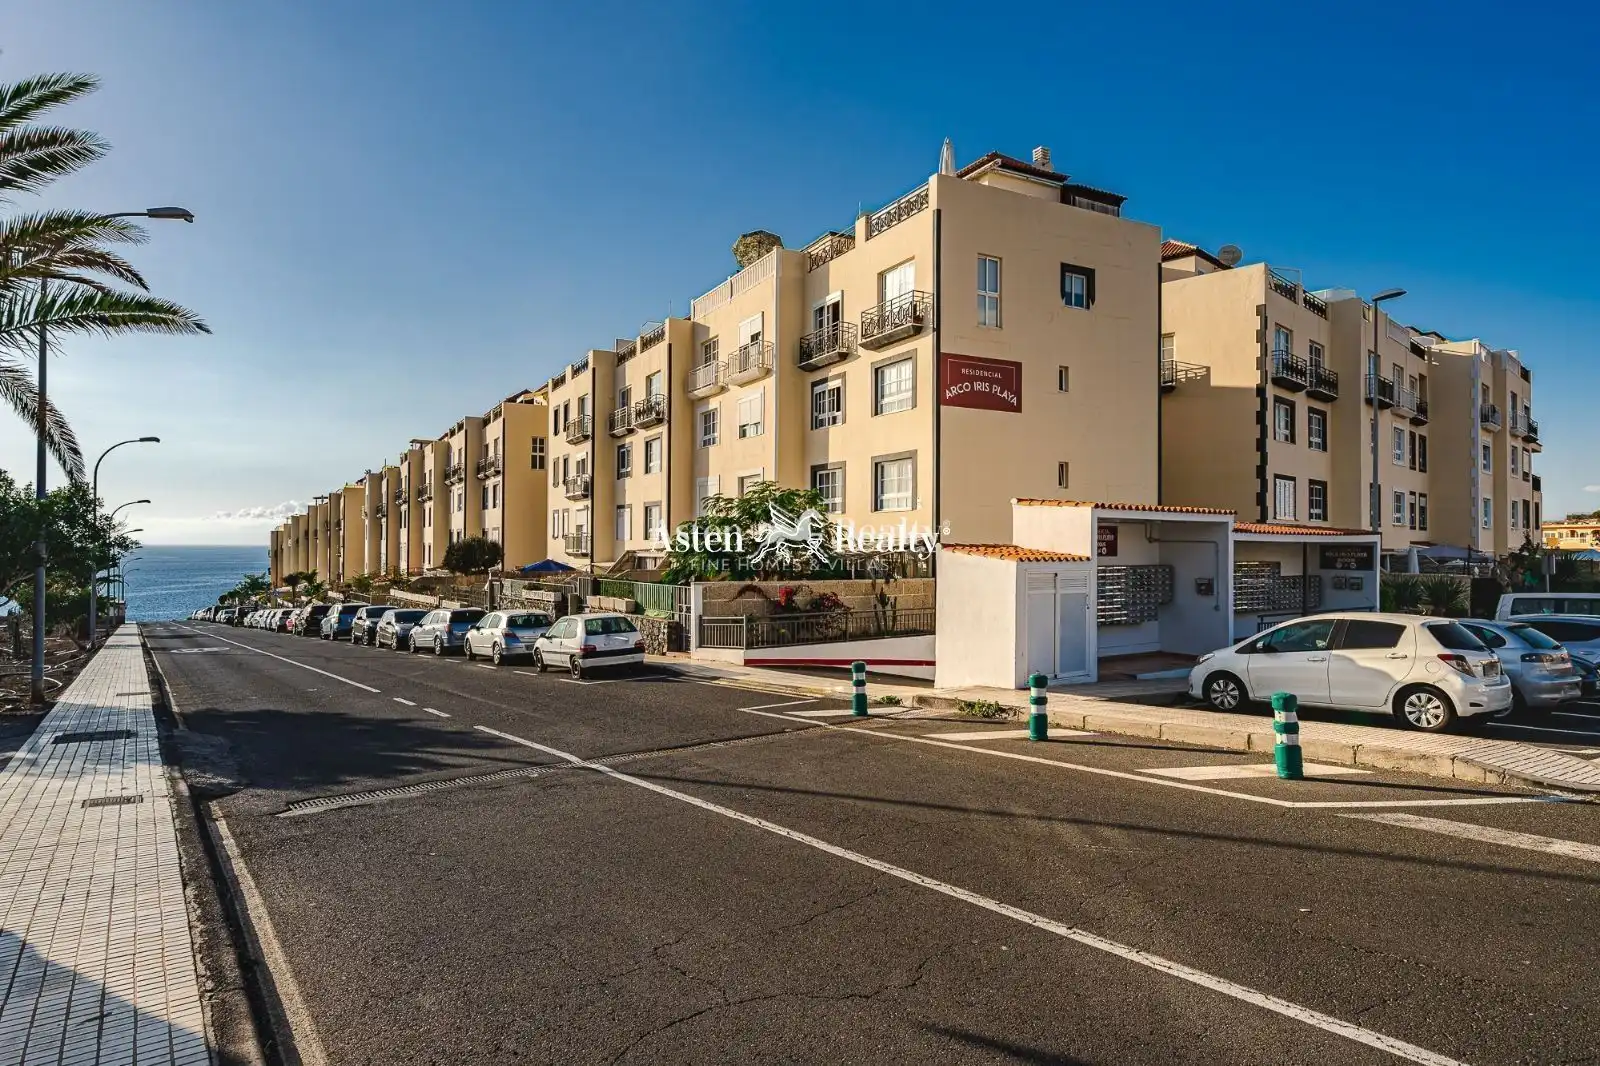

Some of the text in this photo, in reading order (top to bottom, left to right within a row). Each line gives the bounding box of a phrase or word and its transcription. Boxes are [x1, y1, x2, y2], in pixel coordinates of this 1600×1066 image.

[961, 368, 1003, 378] RESIDENCIAL
[945, 381, 1017, 407] ARCO IRIS PLAYA
